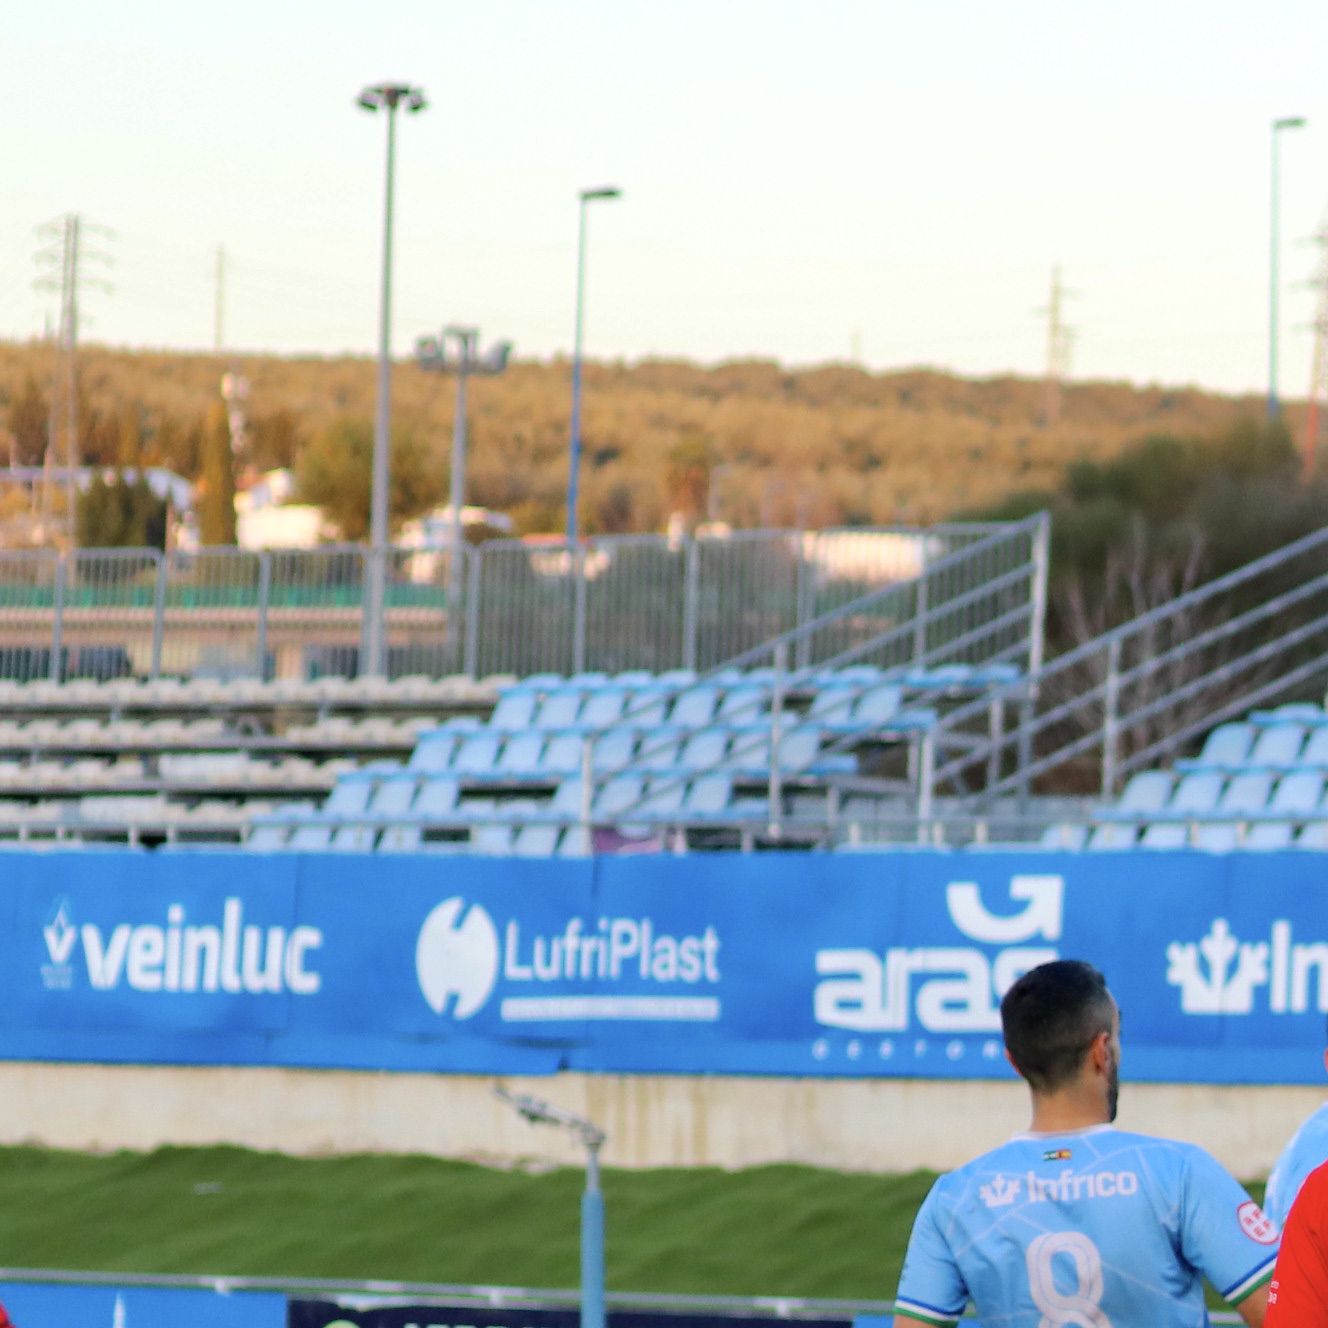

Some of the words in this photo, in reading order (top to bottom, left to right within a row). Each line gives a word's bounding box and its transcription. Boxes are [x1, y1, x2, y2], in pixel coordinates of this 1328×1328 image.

[82, 897, 323, 993] veinluc
[503, 918, 721, 984] LufriPlast
[1026, 1168, 1138, 1203] Infrico
